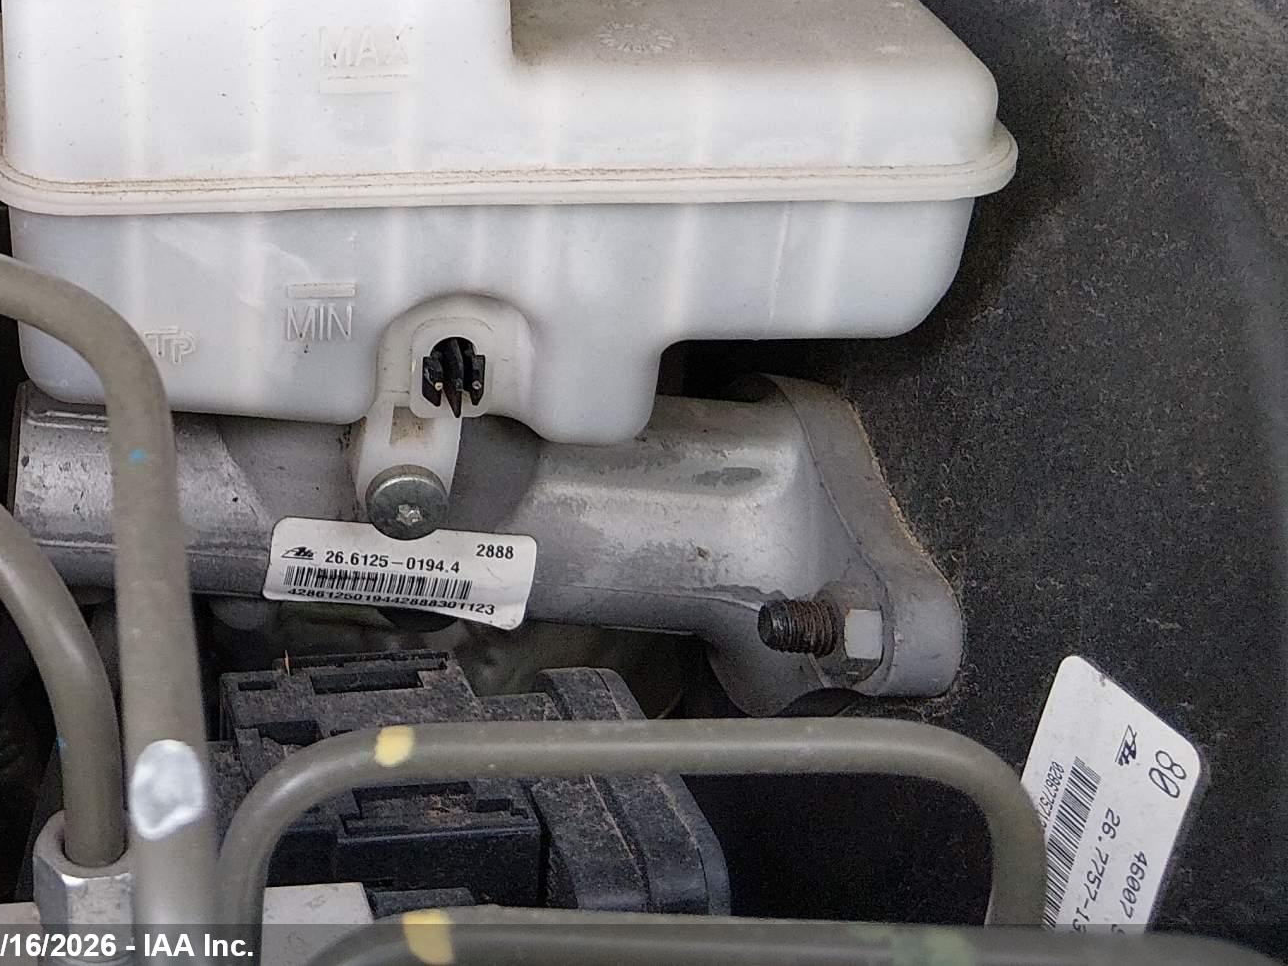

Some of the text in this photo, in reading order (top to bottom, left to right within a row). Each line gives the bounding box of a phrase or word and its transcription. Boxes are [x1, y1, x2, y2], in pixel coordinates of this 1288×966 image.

[319, 26, 410, 67] MAX
[286, 304, 353, 341] MIN
[324, 550, 460, 574] 26.6125-0194.4
[475, 543, 514, 560] 2888
[1149, 751, 1187, 799] 80
[1120, 850, 1149, 919] 46007
